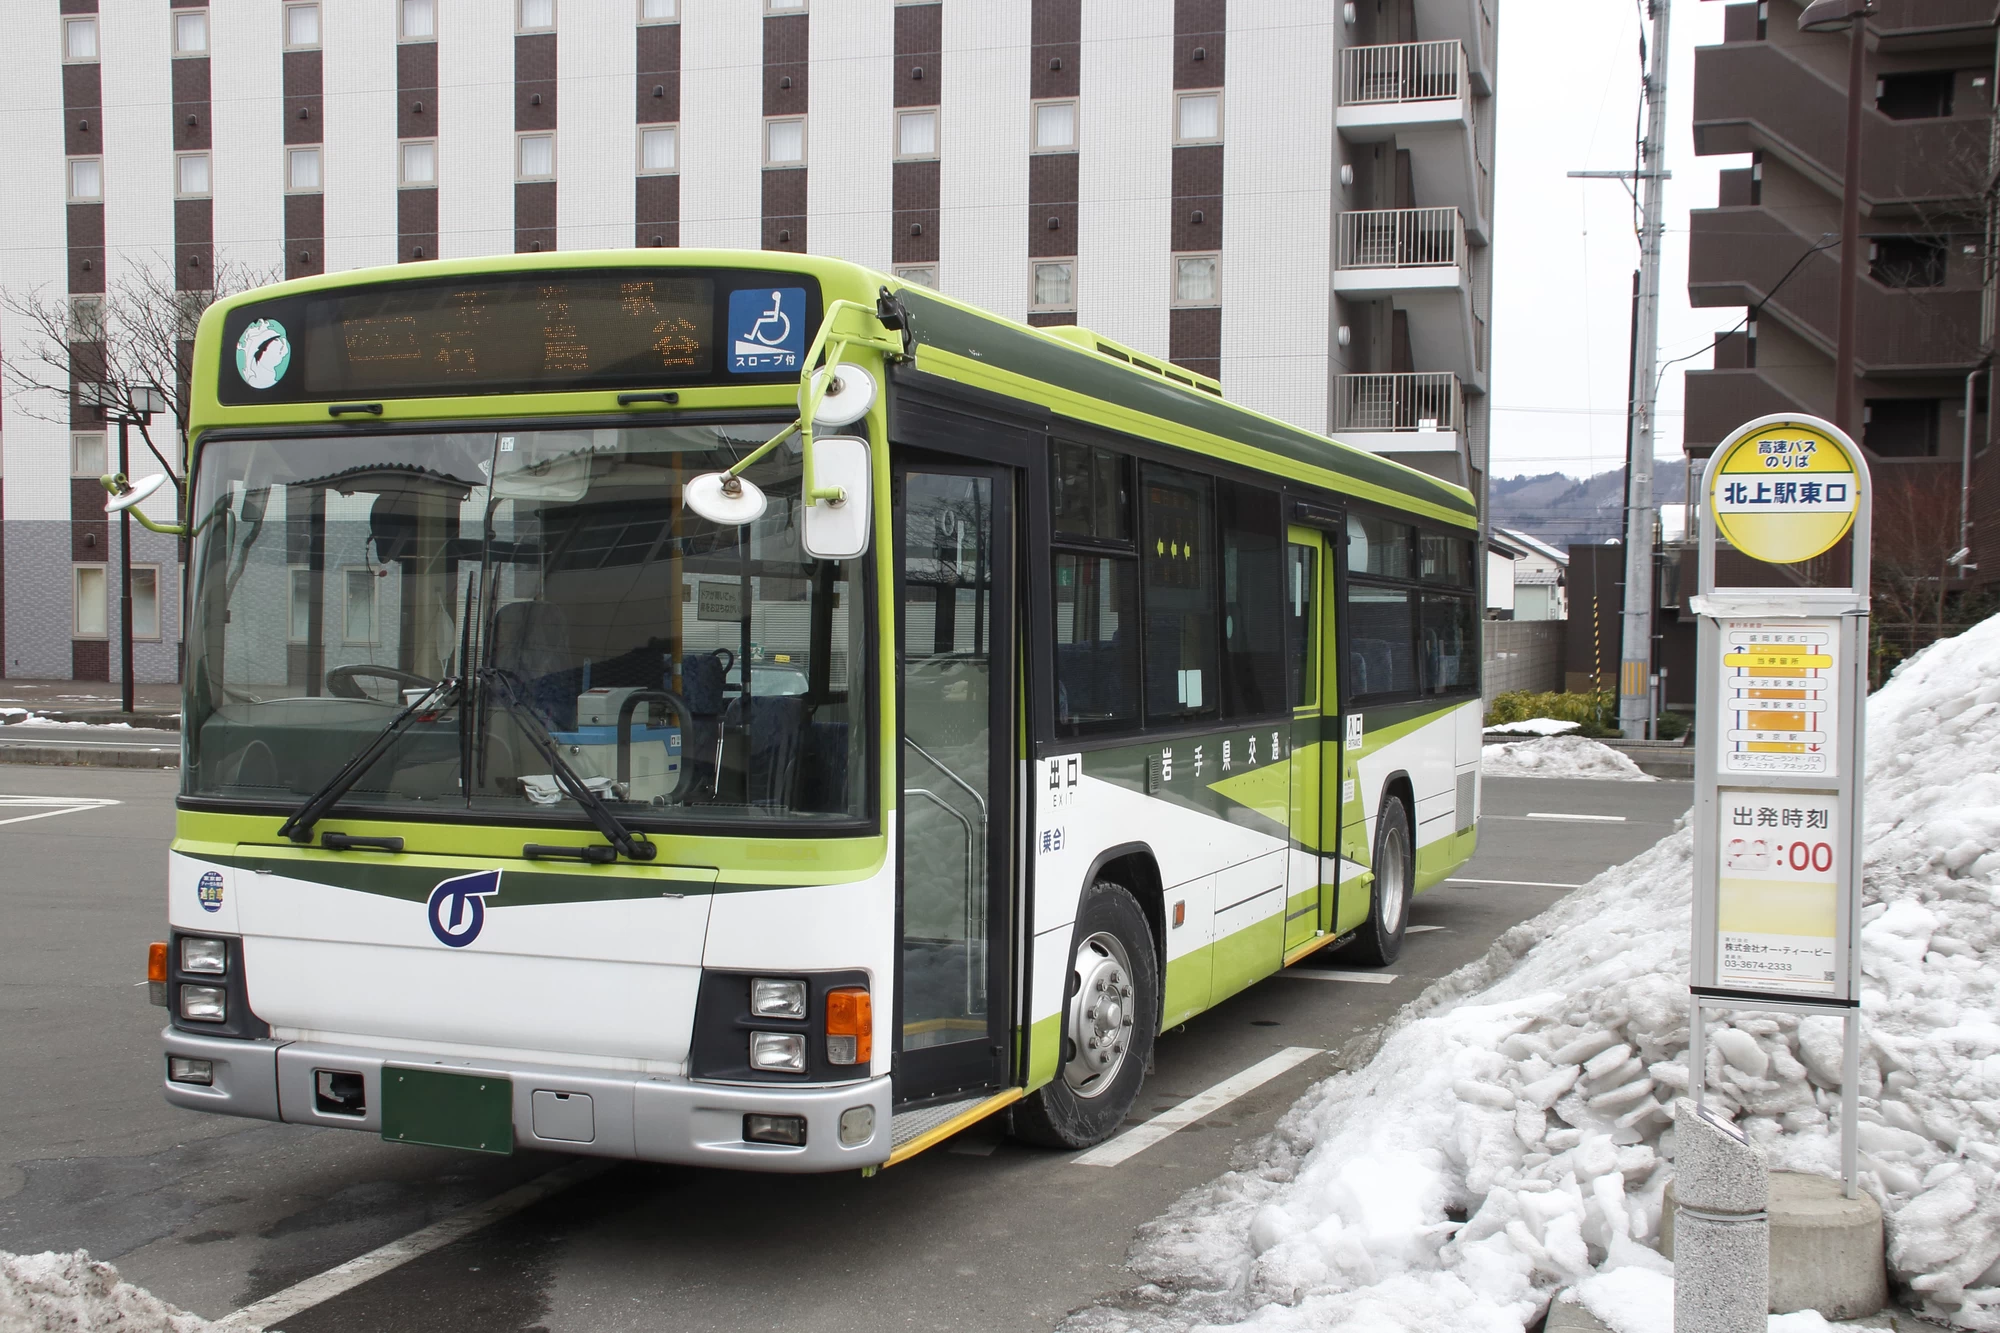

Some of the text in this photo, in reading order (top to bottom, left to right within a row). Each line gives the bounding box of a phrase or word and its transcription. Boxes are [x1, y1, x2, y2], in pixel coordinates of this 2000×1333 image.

[736, 354, 796, 367] スロープ付
[1758, 439, 1817, 454] 高速バス
[1765, 455, 1809, 468] のりば
[1724, 481, 1847, 505] 北上駅東口
[1749, 634, 1808, 643] 盛岡駅西口
[1757, 657, 1800, 665] 当停留所
[1748, 679, 1807, 688] 水沢駅東口
[1748, 701, 1807, 709] 一関駅東口
[1348, 716, 1361, 737] 入口
[1756, 732, 1798, 741] 東京駅
[1162, 731, 1280, 782] 岩手県交通
[1049, 757, 1078, 791] 出口
[1053, 792, 1075, 807] EXIT
[1732, 805, 1829, 830] 出発時刻
[1038, 826, 1066, 856] (乗合)
[1724, 959, 1793, 971] 03-3674-2333
